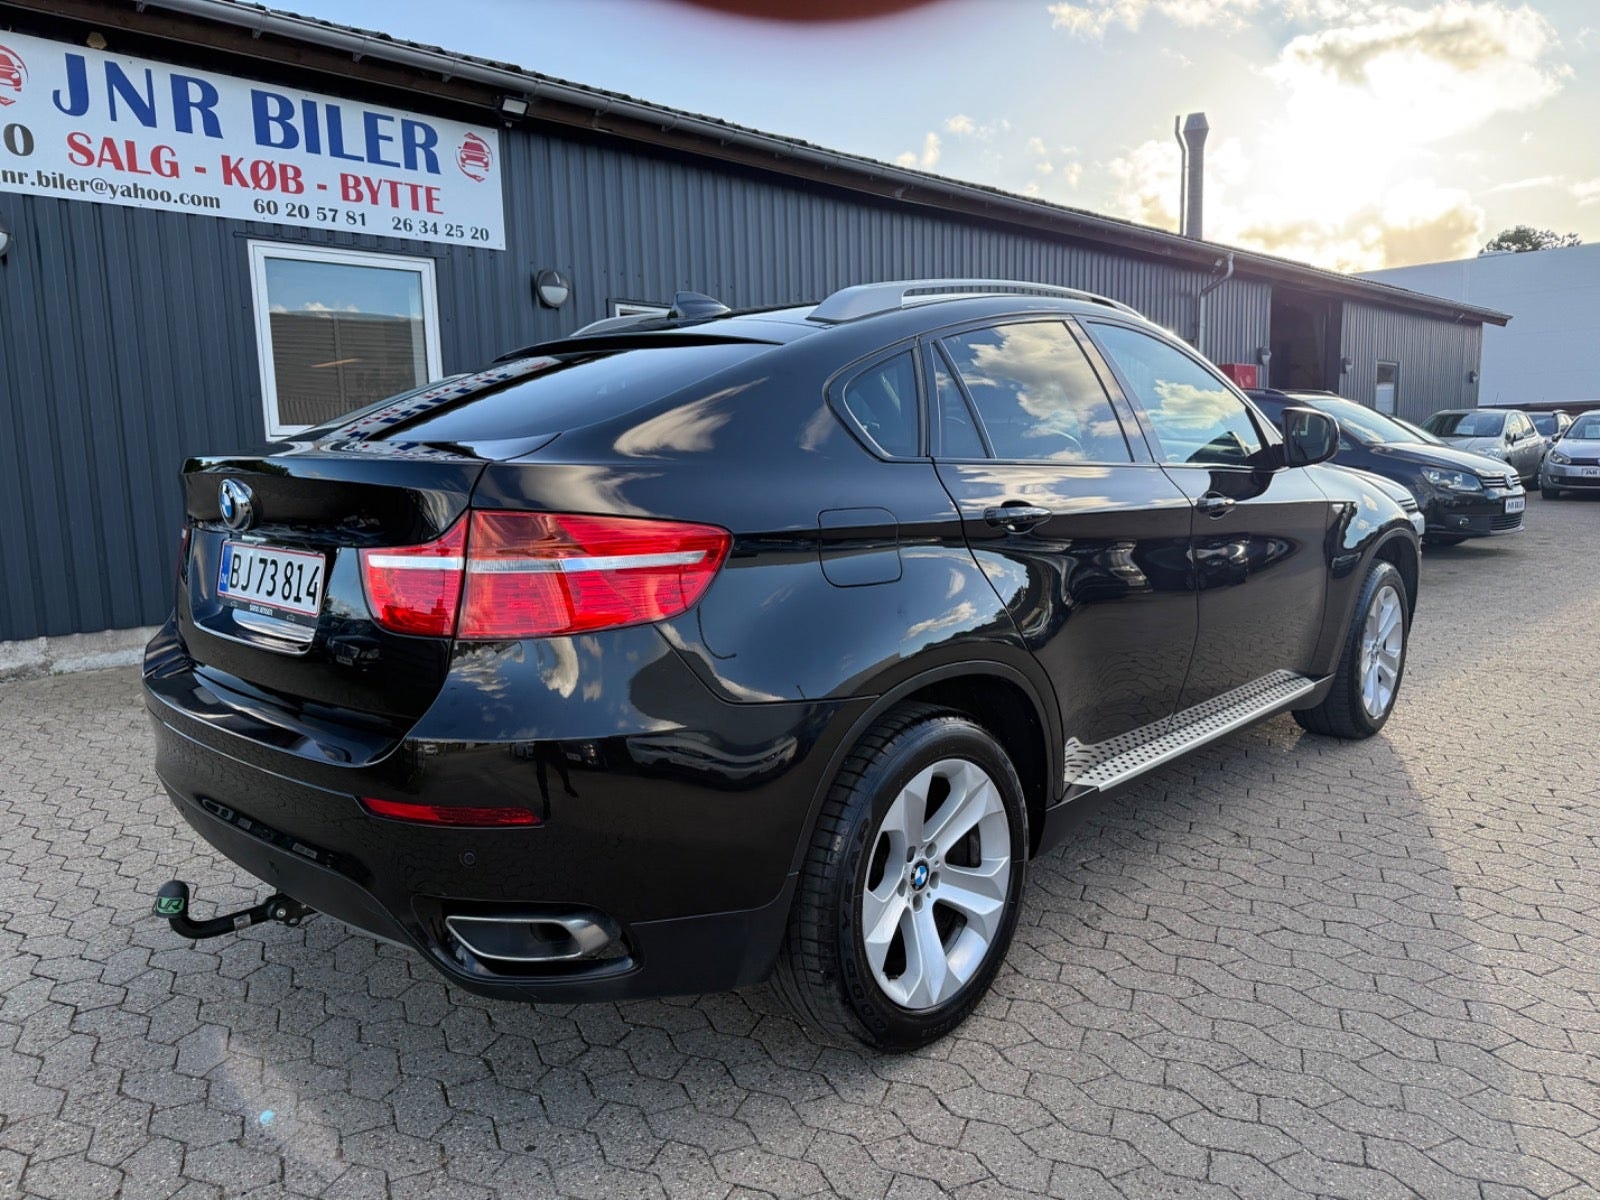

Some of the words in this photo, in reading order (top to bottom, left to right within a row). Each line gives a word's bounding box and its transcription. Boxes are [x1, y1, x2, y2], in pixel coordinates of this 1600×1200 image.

[53, 52, 223, 139] JNR
[251, 88, 441, 175] BILER
[0, 169, 221, 209] nr.biler@yahoo.com
[66, 131, 180, 178] SALG
[220, 154, 304, 195] KØB
[340, 173, 444, 215] BYTTE
[253, 198, 279, 215] 60
[285, 203, 310, 219] 20
[316, 206, 338, 223] 57
[345, 210, 366, 226] 81
[391, 216, 413, 232] 26
[418, 219, 438, 235] 34
[444, 223, 465, 238] 25
[470, 226, 490, 241] 20
